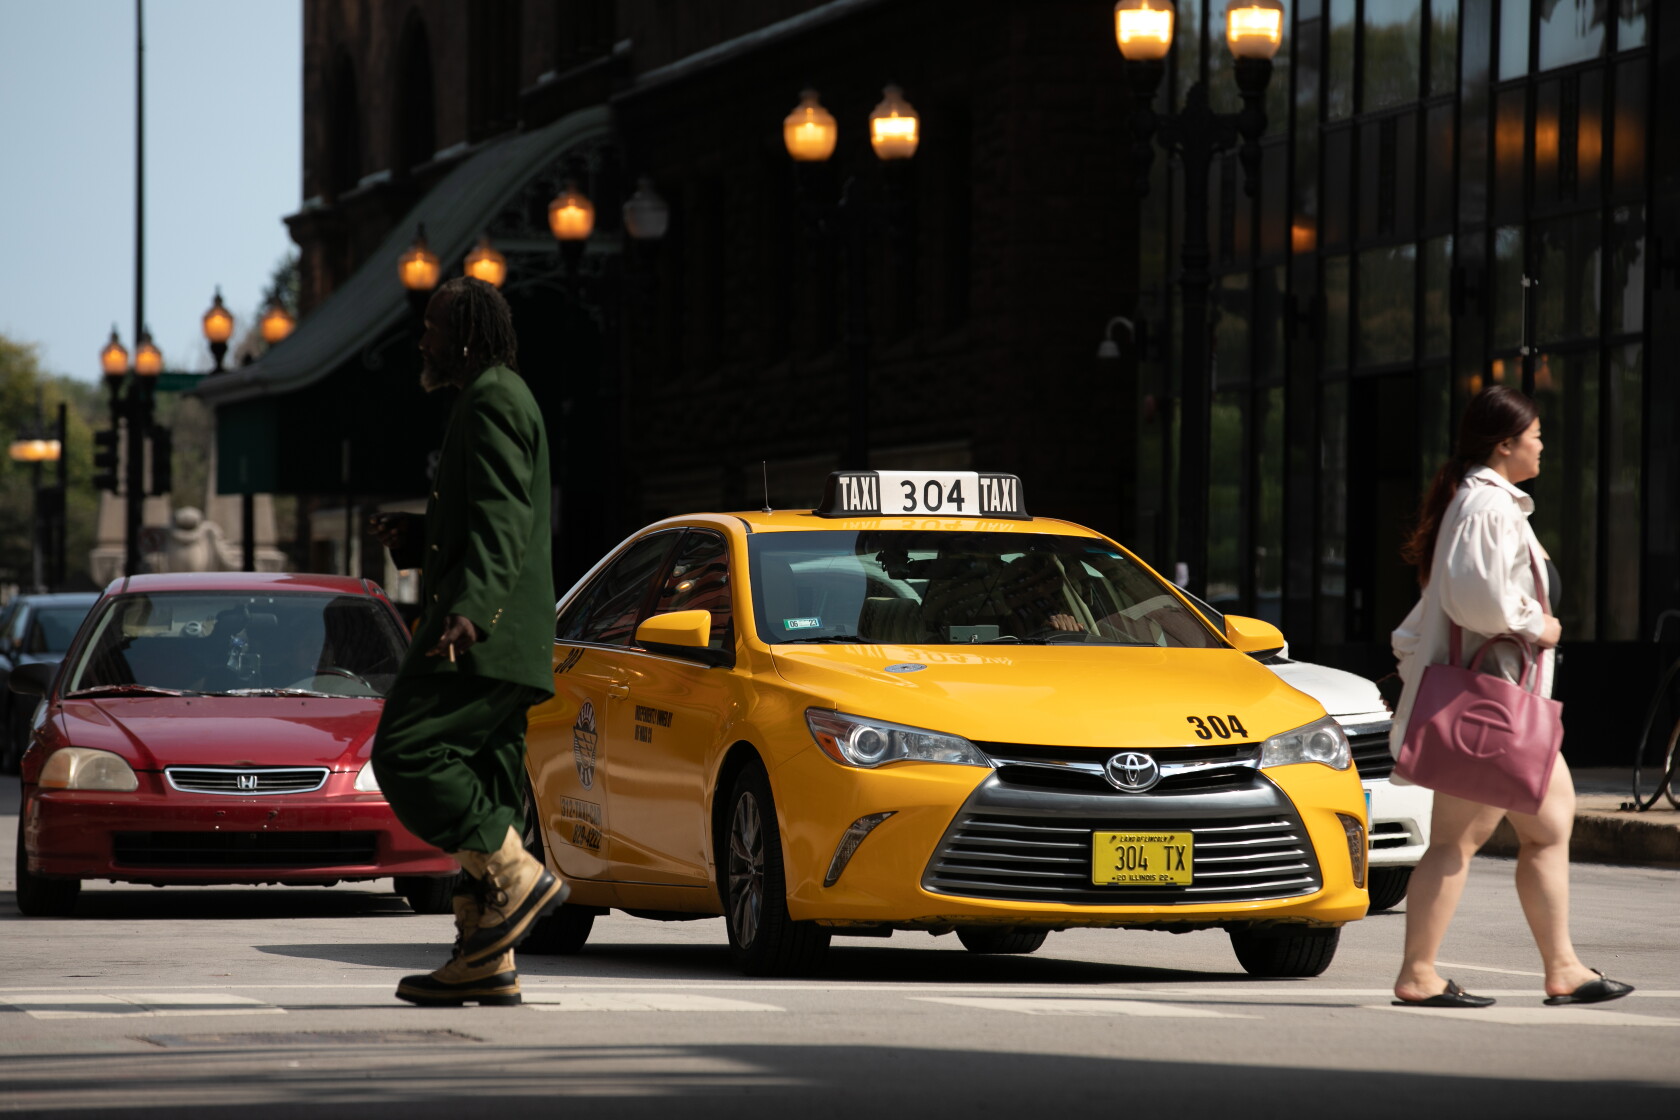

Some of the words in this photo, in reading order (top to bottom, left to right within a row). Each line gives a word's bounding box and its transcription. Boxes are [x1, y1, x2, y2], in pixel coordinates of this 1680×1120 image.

[839, 477, 878, 511] TAXI
[900, 479, 965, 512] 304
[980, 478, 1017, 512] TAXI
[789, 620, 798, 628] 06
[809, 619, 817, 627] 23
[1187, 715, 1248, 740] 304
[572, 823, 602, 849] 829-4222
[1115, 845, 1148, 871] 304
[1164, 845, 1186, 871] TX
